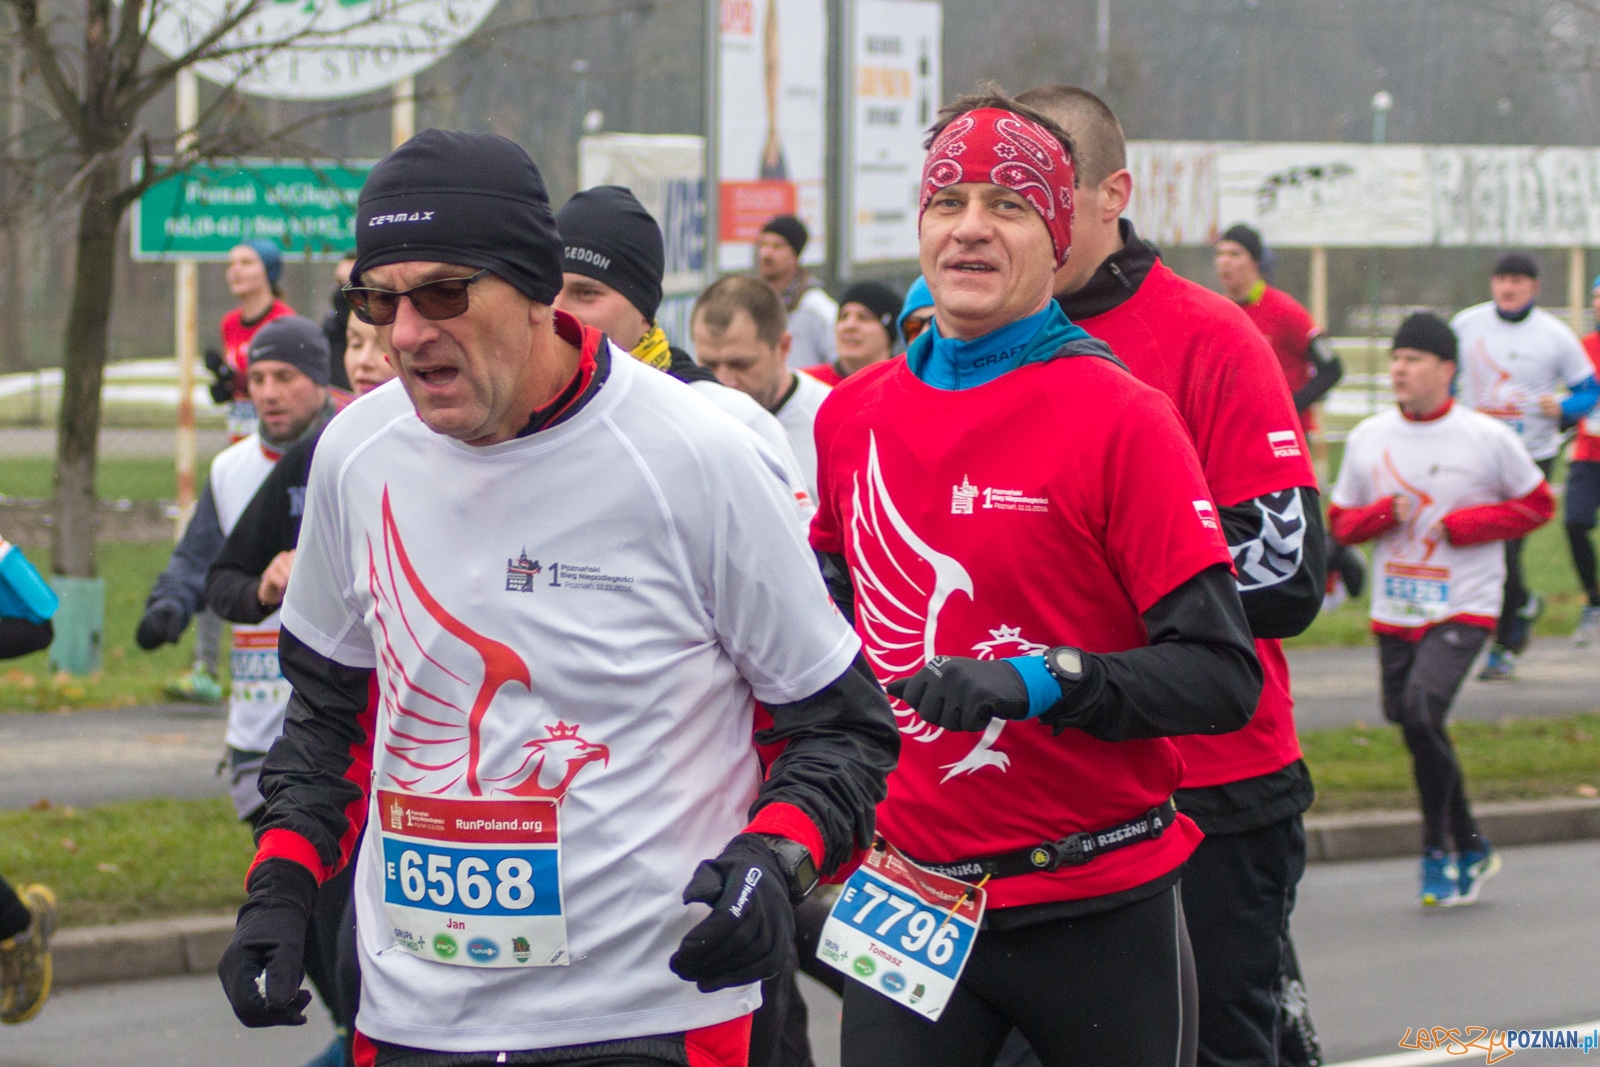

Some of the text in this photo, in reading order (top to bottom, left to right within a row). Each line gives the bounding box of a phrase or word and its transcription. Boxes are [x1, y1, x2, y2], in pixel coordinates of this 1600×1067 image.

[564, 246, 611, 270] GEDDON
[982, 487, 993, 509] 1
[548, 562, 562, 588] 1
[455, 819, 543, 833] RunPoland.org
[387, 849, 535, 910] E 6568
[446, 918, 466, 931] Jan
[843, 881, 960, 966] E 7796
[868, 942, 903, 967] Tomasz
